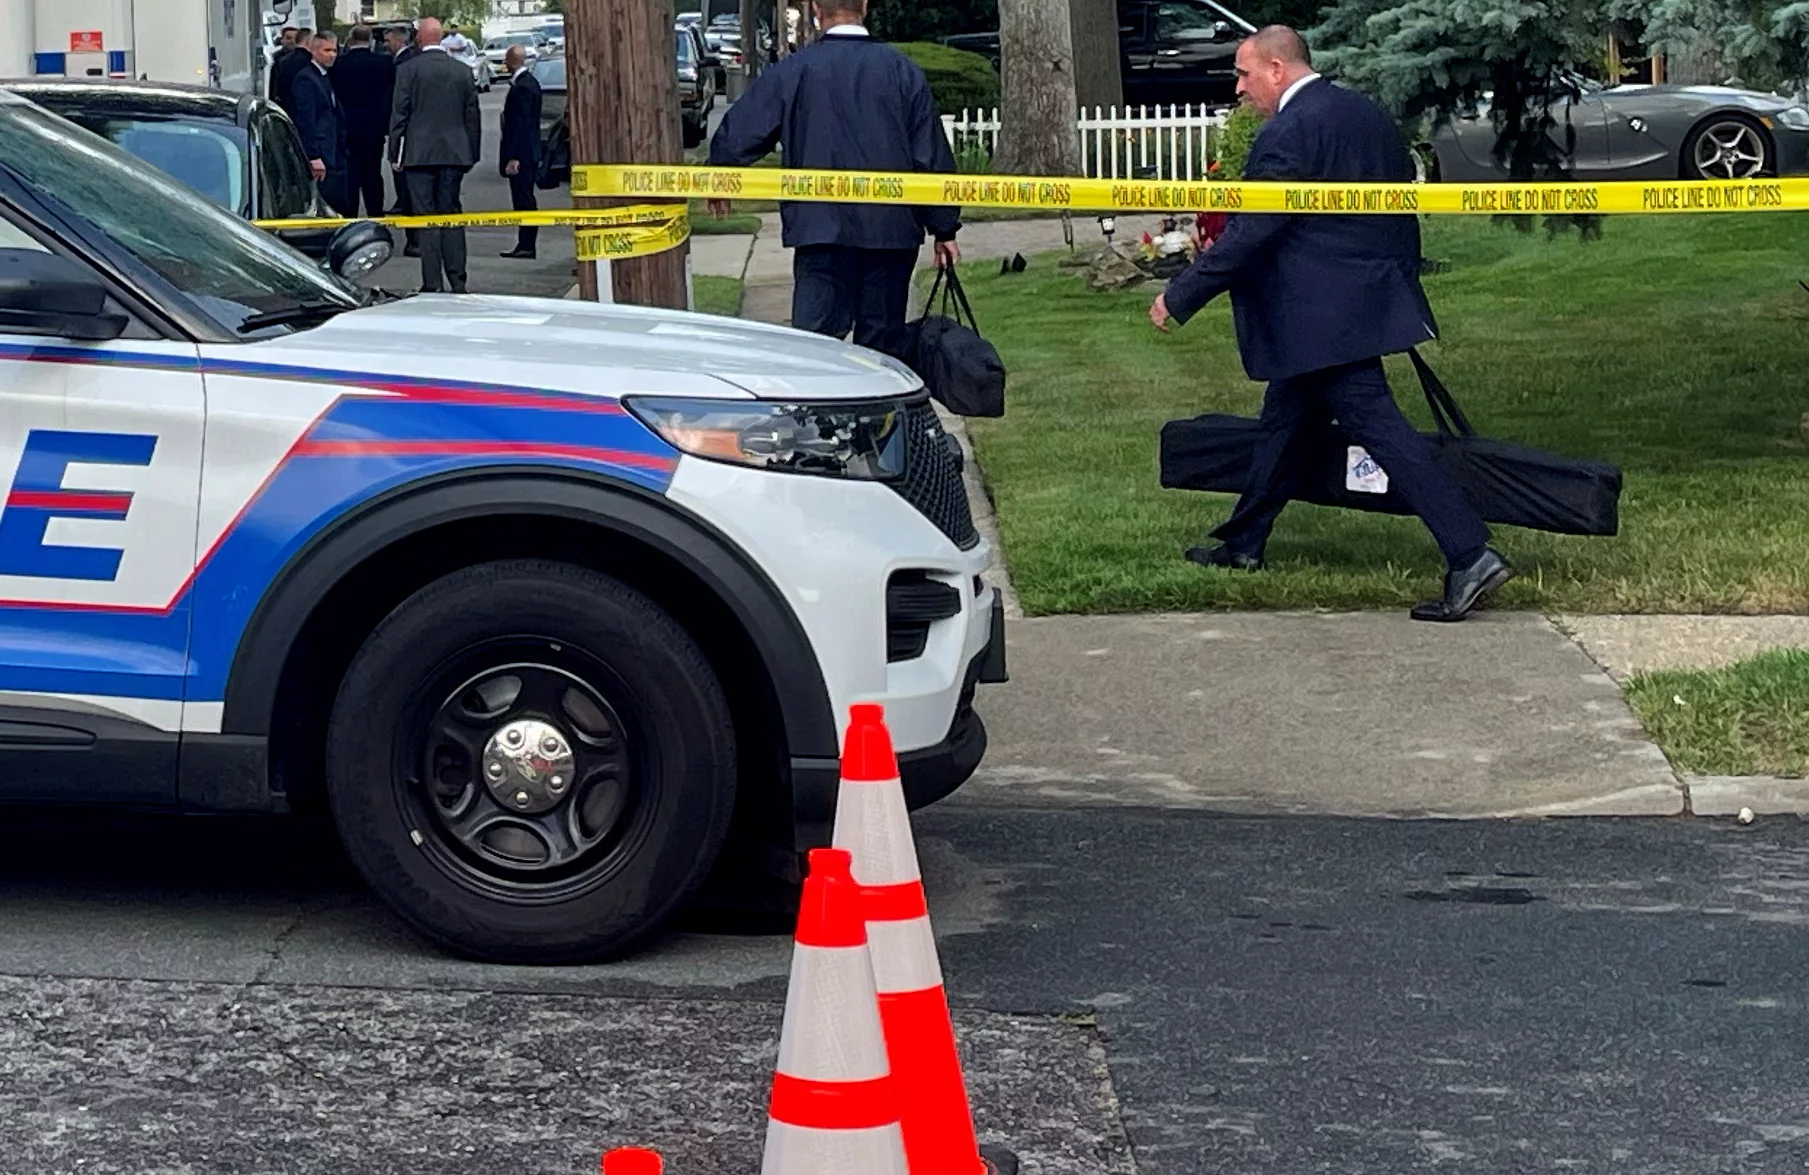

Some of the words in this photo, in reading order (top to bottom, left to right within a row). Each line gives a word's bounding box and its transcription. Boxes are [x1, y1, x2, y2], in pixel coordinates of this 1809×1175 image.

[623, 171, 653, 193] POLICE
[656, 172, 677, 192] LINE
[678, 172, 691, 192] DO
[693, 173, 711, 192] NOT
[712, 173, 742, 194] CROSS
[781, 174, 813, 196] POLICE
[815, 175, 835, 197] LINE
[837, 176, 851, 197] DO
[853, 177, 870, 198] NOT
[873, 177, 904, 199] CROSS
[943, 180, 977, 202] POLICE
[979, 181, 999, 203] LINE
[1002, 182, 1016, 203] DO
[1018, 183, 1036, 204] NOT
[1039, 183, 1071, 205] CROSS
[1112, 185, 1146, 206] POLICE
[1149, 186, 1170, 207] LINE
[1172, 187, 1186, 207] DO
[1188, 187, 1207, 208] NOT
[1210, 187, 1242, 208] CROSS
[1285, 189, 1320, 210] POLICE
[1322, 190, 1344, 210] LINE
[1346, 190, 1360, 210] DO
[1363, 190, 1382, 210] NOT
[1385, 190, 1418, 211] CROSS
[1462, 190, 1497, 211] POLICE
[1500, 190, 1521, 210] LINE
[1525, 190, 1539, 210] DO
[1542, 189, 1562, 210] NOT
[1565, 188, 1598, 209] CROSS
[1643, 188, 1679, 209] POLICE
[1682, 187, 1704, 208] LINE
[1707, 186, 1721, 207] DO
[1724, 186, 1743, 207] NOT
[1747, 184, 1781, 206] CROSS
